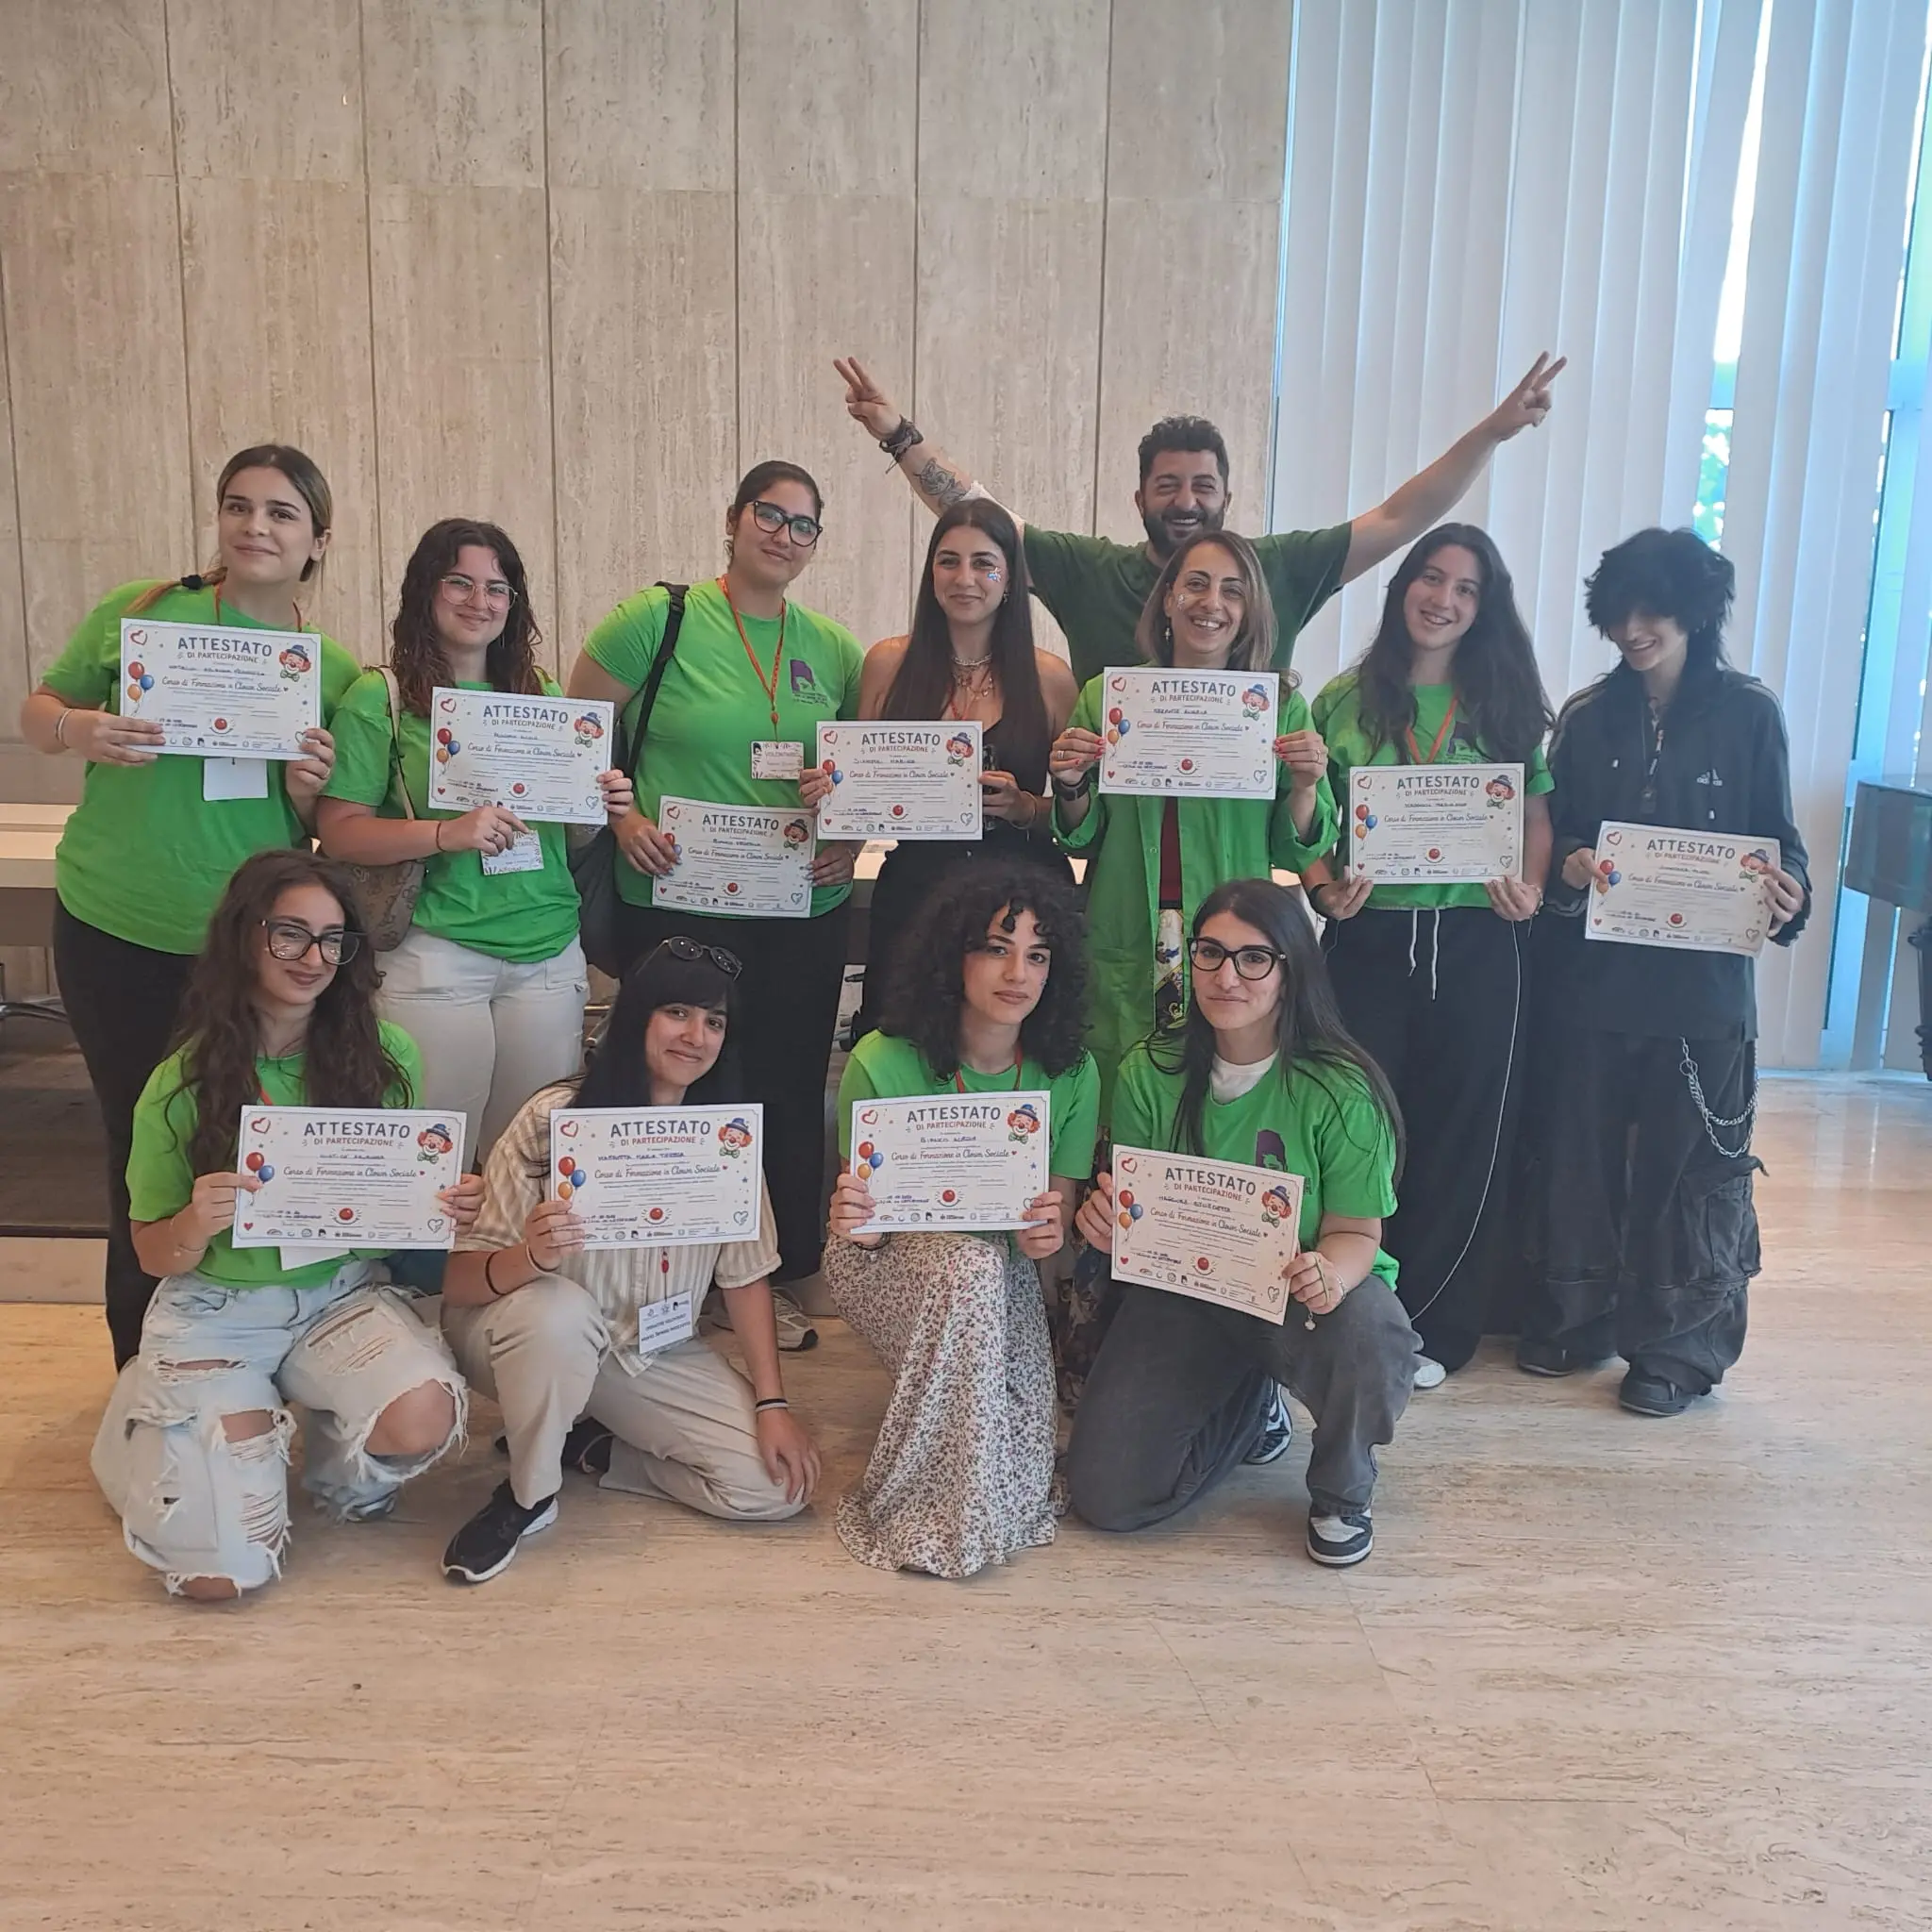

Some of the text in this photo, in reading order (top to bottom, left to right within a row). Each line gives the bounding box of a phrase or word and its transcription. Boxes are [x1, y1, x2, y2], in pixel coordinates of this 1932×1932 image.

[178, 638, 272, 657] ATTESTATO
[1152, 681, 1236, 696] ATTESTATO
[483, 706, 569, 724] ATTESTATO
[862, 733, 941, 745] ATTESTATO
[1397, 776, 1479, 791] ATTESTATO
[703, 814, 779, 830] ATTESTATO
[1647, 839, 1736, 859] ATTESTATO
[908, 1107, 1001, 1123] ATTESTATO
[304, 1123, 410, 1138] ATTESTATO
[610, 1121, 710, 1138] ATTESTATO
[325, 1138, 394, 1146] PARTECIPAZIONE
[632, 1137, 696, 1145] PARTECIPAZIONE
[920, 1151, 954, 1159] Formazione
[594, 1170, 613, 1179] Corso
[615, 1169, 623, 1178] di
[625, 1167, 661, 1178] Formazione
[694, 1164, 720, 1174] Sociale
[1165, 1167, 1256, 1196] ATTESTATO
[1184, 1185, 1242, 1201] PARTECIPAZIONE
